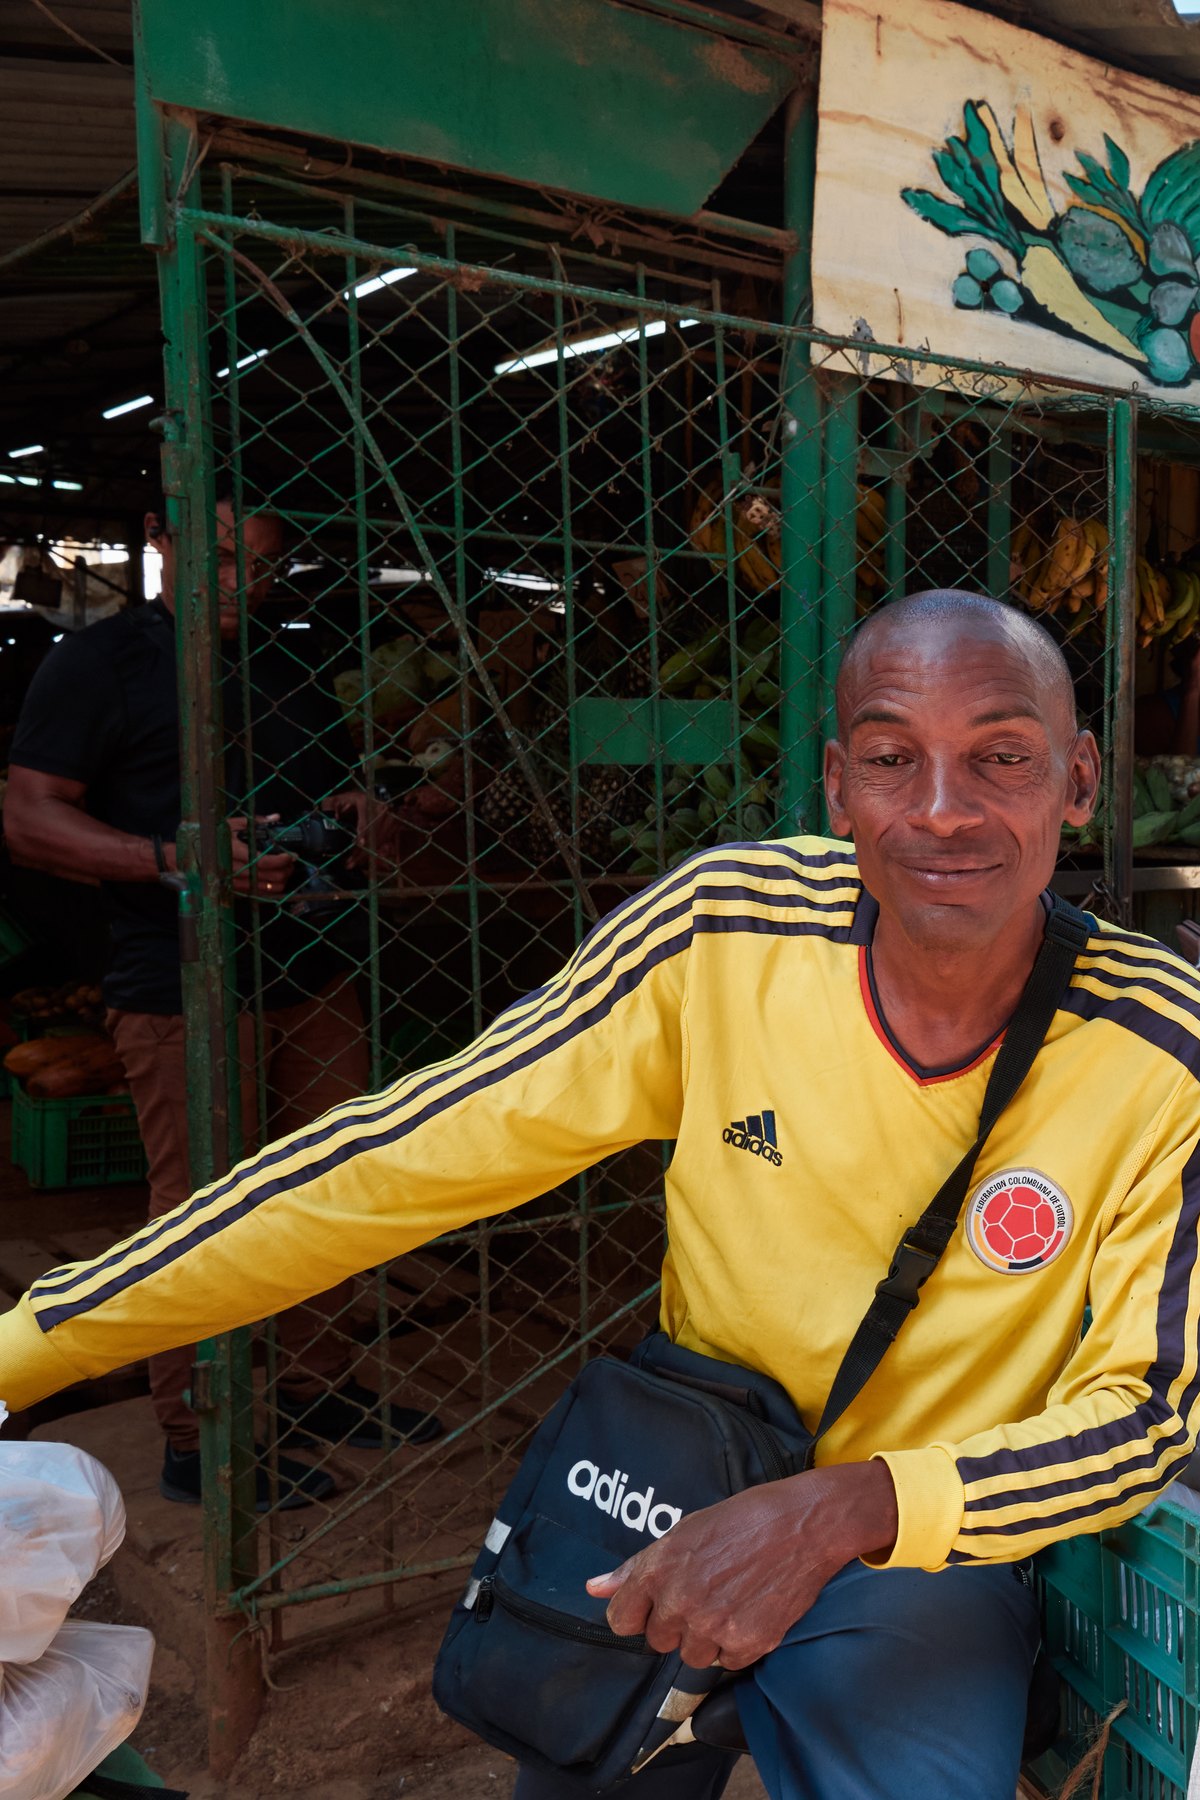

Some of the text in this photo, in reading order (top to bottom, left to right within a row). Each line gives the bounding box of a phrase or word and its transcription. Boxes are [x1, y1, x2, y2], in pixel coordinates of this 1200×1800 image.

[722, 1127, 783, 1167] adidas
[975, 1176, 1066, 1229] FEDERACION COLOMBIANA DE FUTBOL
[567, 1459, 682, 1539] adida
